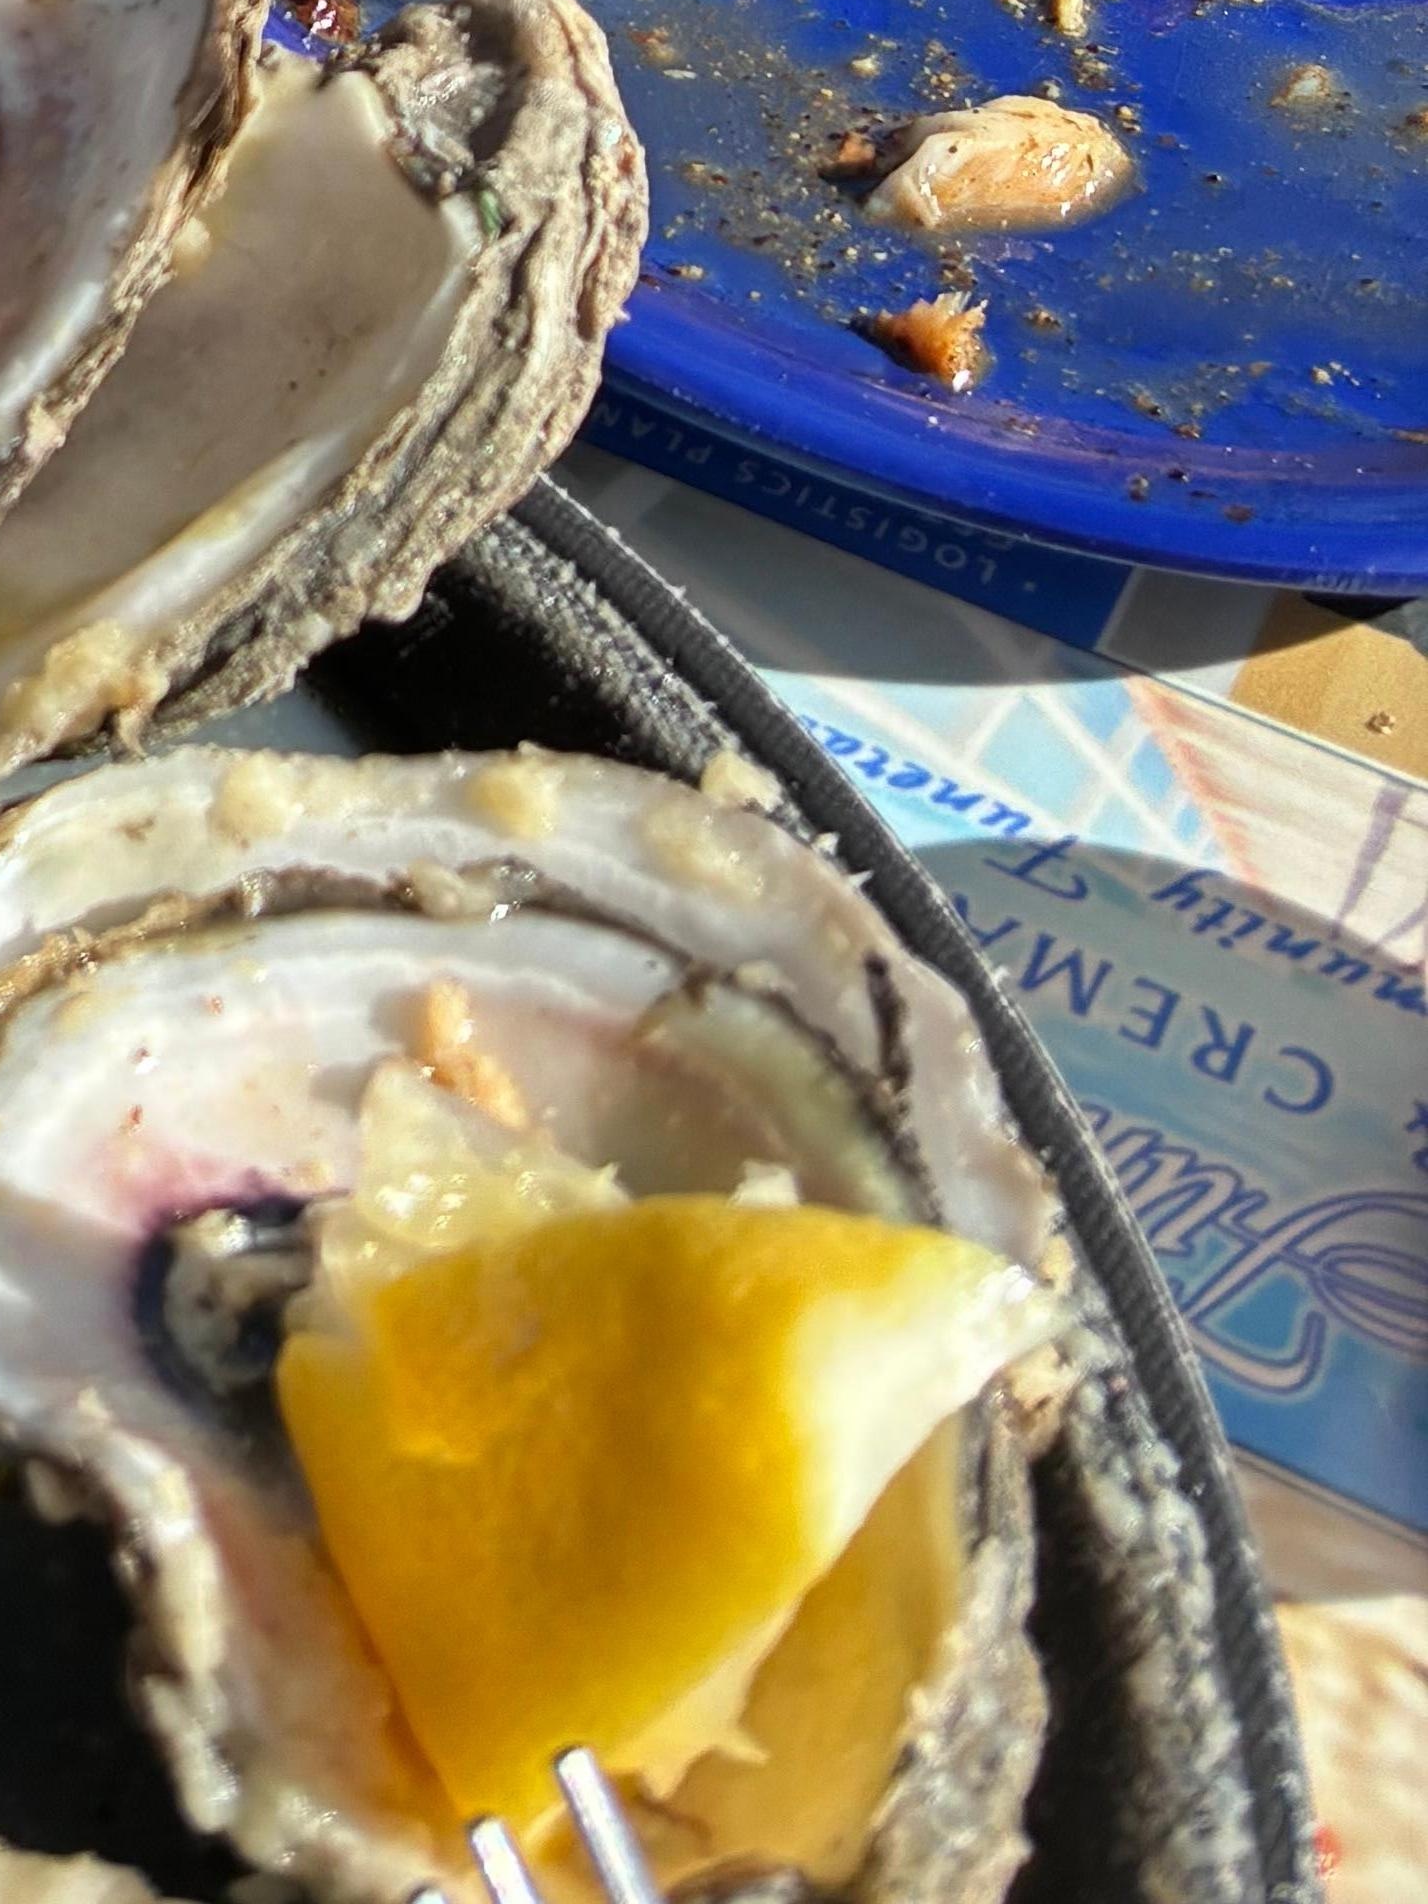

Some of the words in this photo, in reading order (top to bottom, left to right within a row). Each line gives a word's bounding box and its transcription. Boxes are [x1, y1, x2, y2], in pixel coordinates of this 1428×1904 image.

[590, 402, 714, 465] PLAN
[736, 459, 999, 585] LOGISTICS
[801, 713, 1091, 901] Funera
